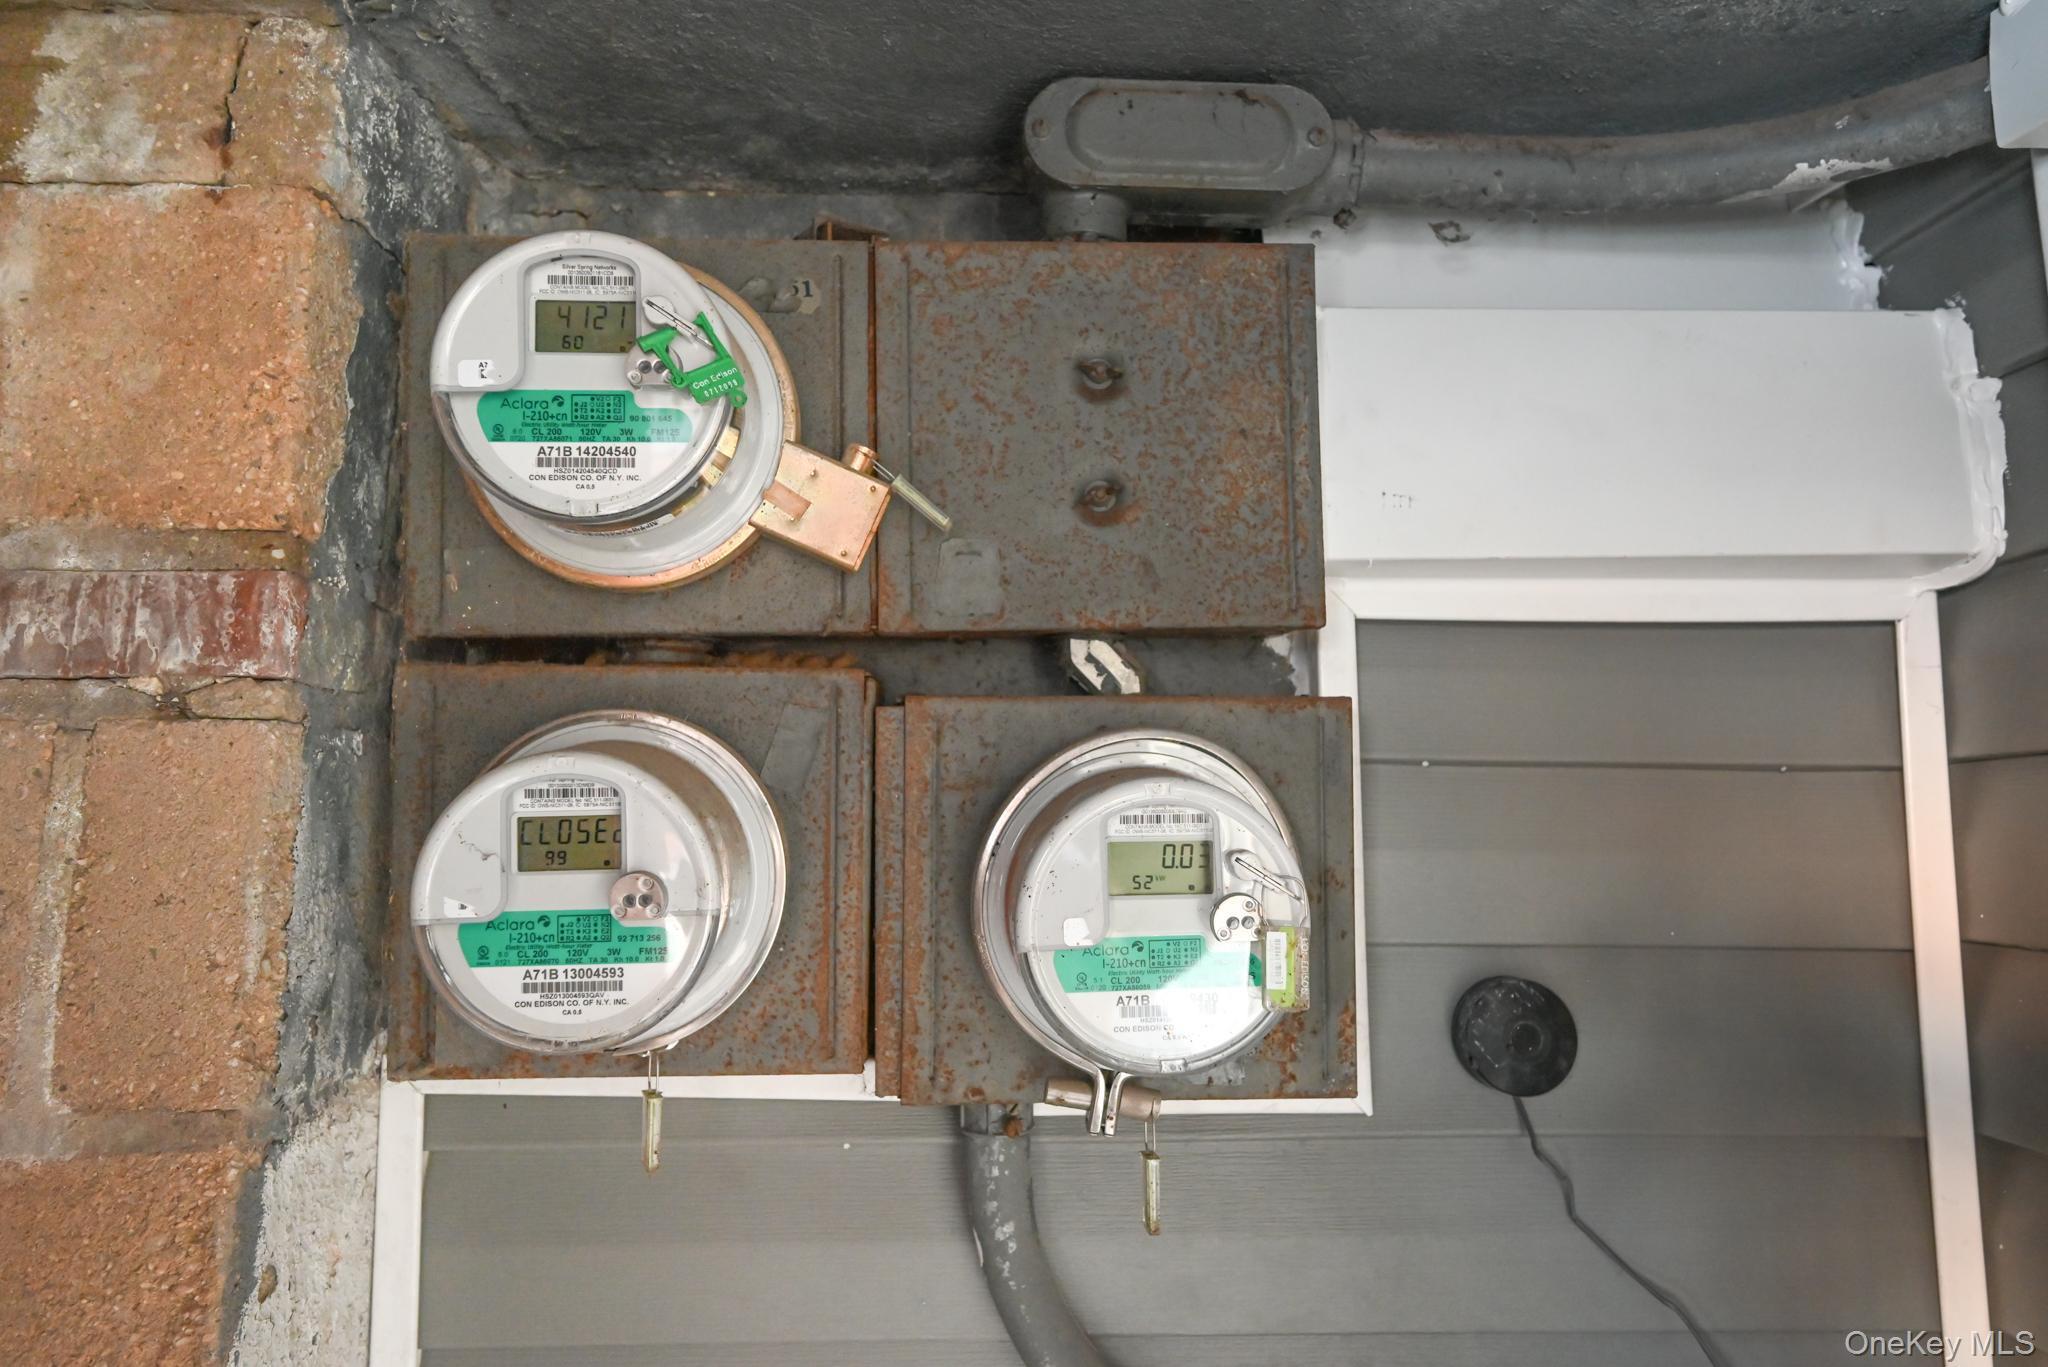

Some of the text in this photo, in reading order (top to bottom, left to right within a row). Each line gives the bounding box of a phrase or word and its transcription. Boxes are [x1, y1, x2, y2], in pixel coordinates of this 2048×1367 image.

[557, 304, 626, 330] 4121
[561, 335, 584, 350] 60
[692, 367, 738, 390] Con Edison
[500, 396, 549, 410] Aclara
[531, 428, 544, 436] CL
[546, 428, 562, 436] 200
[580, 428, 602, 436] 120V
[620, 428, 634, 436] 3W
[537, 446, 636, 456] A71B 14204540
[545, 850, 567, 866] 99
[1132, 875, 1154, 890] 52
[485, 918, 535, 931] Aclara
[517, 950, 530, 958] CL
[532, 950, 549, 958] 200
[567, 949, 589, 957] 120V
[607, 948, 621, 956] 3W
[1082, 944, 1129, 956] Aclara
[522, 967, 624, 980] A71B 13004593
[1110, 976, 1122, 984] CL
[1125, 976, 1140, 984] 200
[1116, 994, 1150, 1006] A71B
